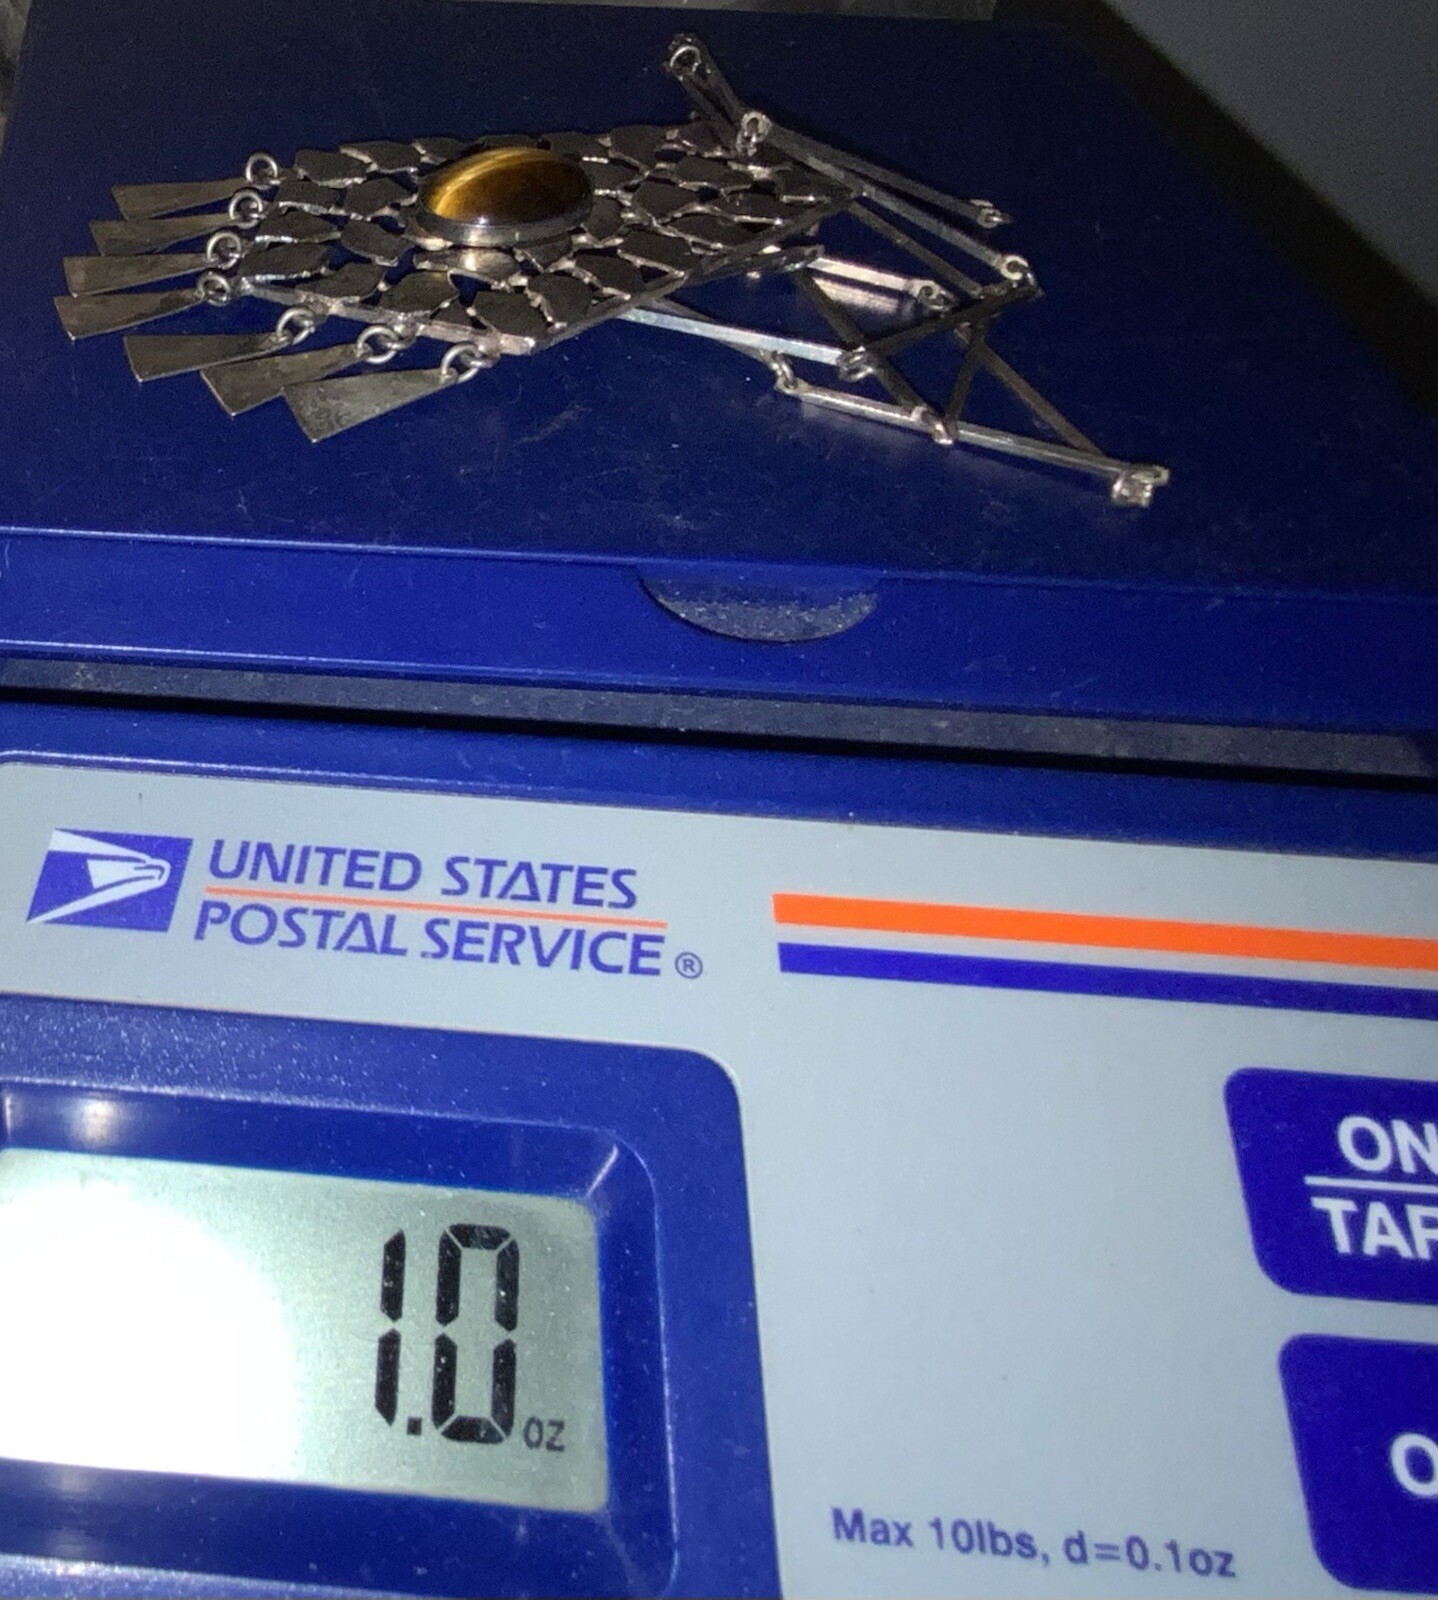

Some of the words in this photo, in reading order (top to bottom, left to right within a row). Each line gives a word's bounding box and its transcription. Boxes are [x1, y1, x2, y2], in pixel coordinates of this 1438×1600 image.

[207, 839, 422, 892] UNITED
[440, 855, 638, 910] STATES
[194, 900, 408, 957] POSTAL
[420, 916, 666, 977] SERVICE
[374, 1222, 521, 1445] 1.0
[831, 1506, 914, 1548] Max
[928, 1517, 1050, 1568] 10lbs,
[1062, 1530, 1237, 1579] d=0.1oz
